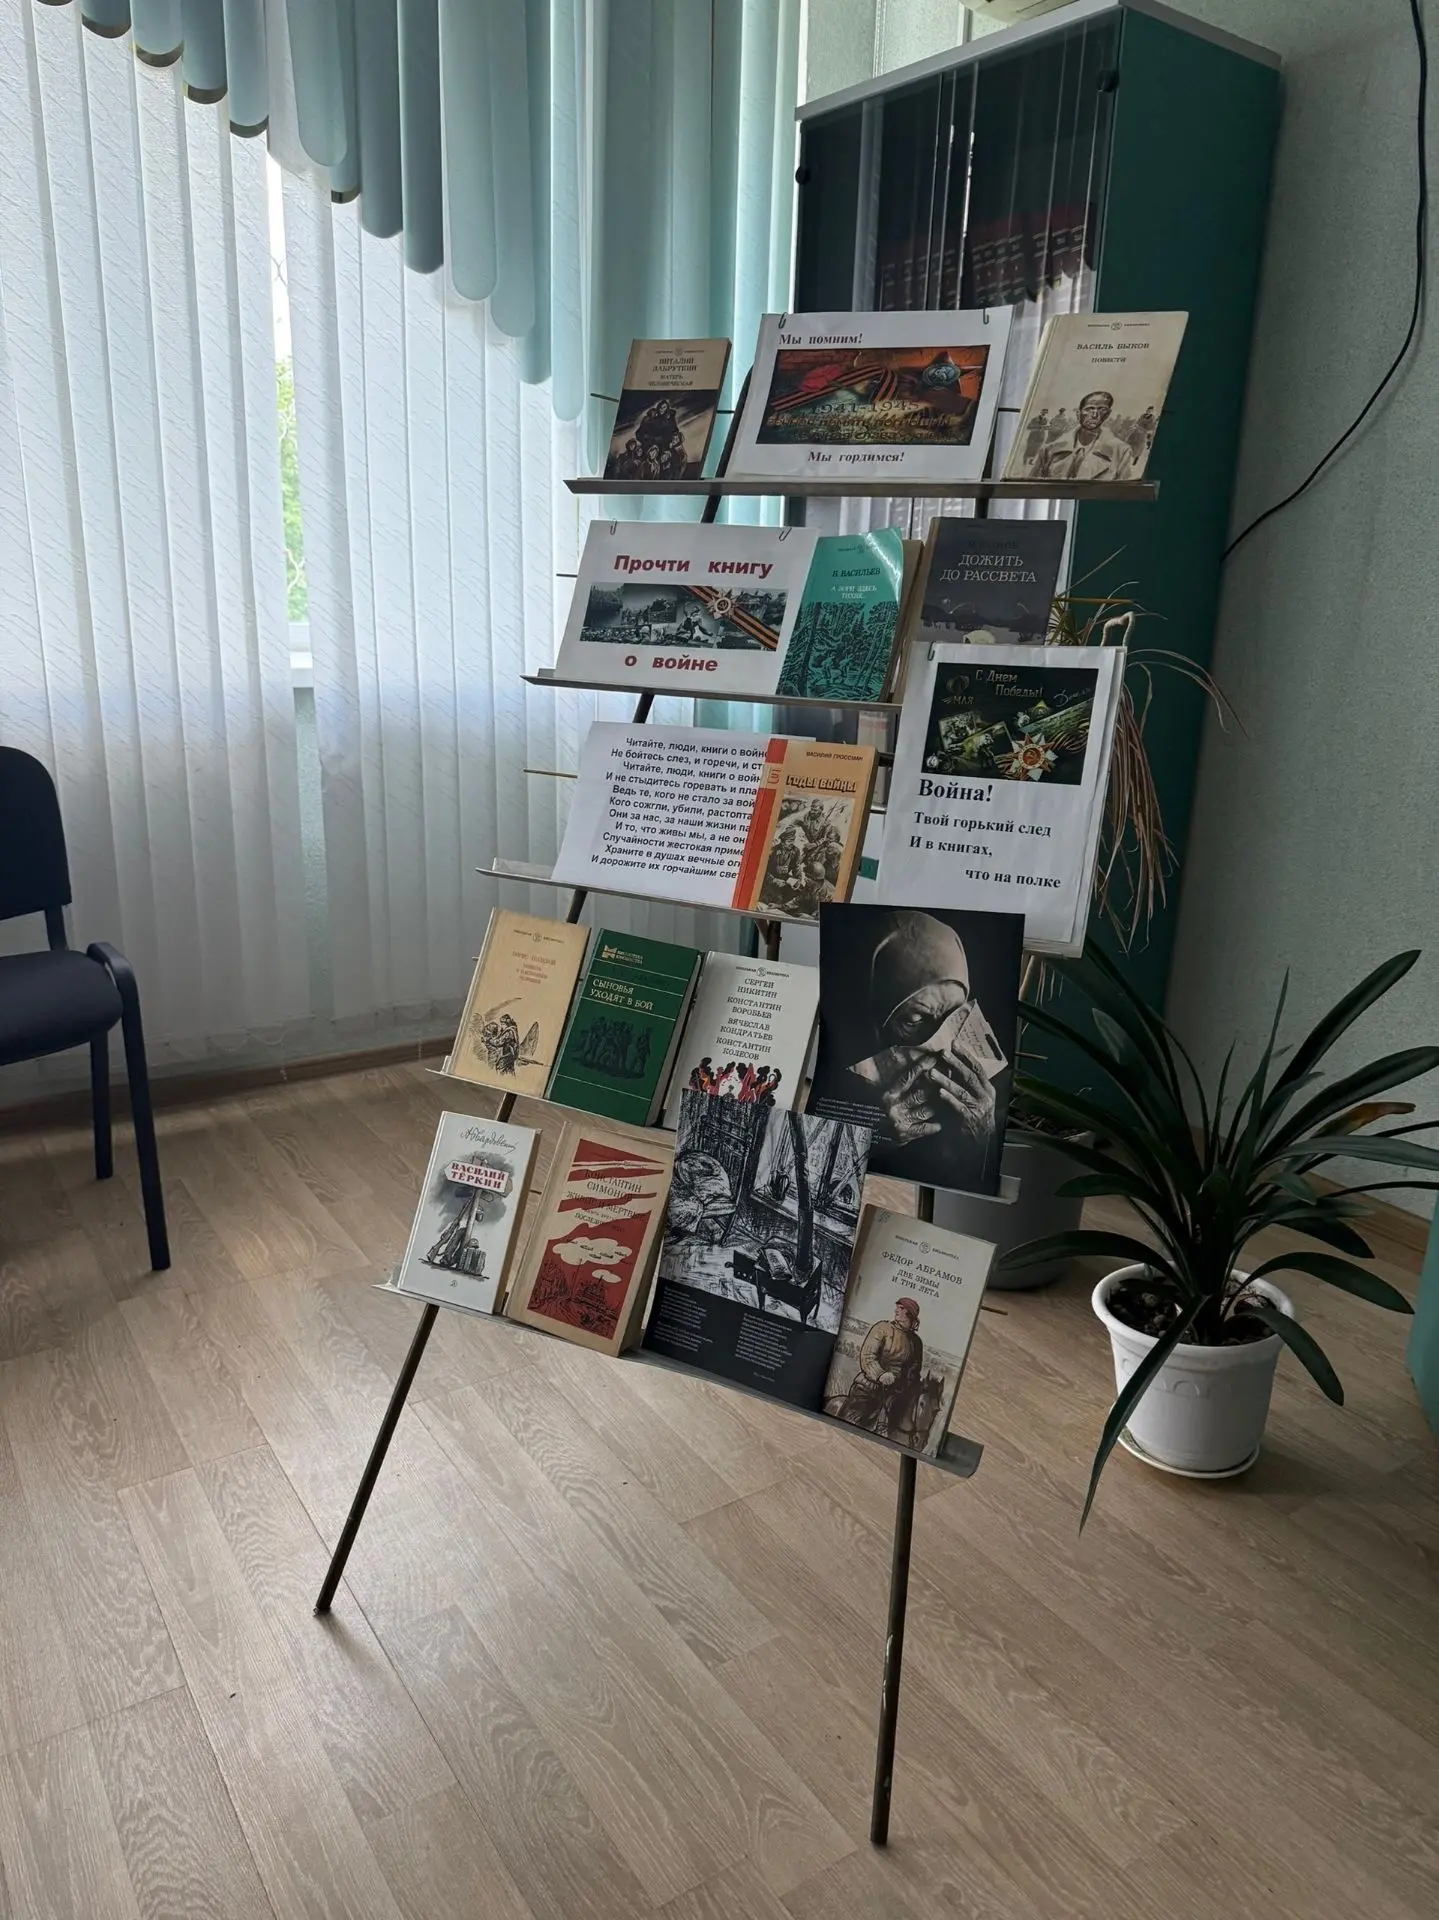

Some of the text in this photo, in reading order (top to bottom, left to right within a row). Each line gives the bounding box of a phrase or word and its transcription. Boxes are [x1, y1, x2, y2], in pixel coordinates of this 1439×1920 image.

[778, 333, 863, 345] Мы помним!
[1117, 342, 1150, 350] БЫКОВ
[811, 400, 920, 414] 1941-1945
[808, 452, 905, 464] Мы гордимся!
[613, 555, 774, 579] Прочти книгу
[957, 554, 1024, 567] ДОЖИТЬ
[840, 567, 881, 577] ВАСИЛЬЕВ
[939, 569, 1037, 583] ДО РАССВЕТА
[624, 653, 718, 672] о войне
[975, 669, 1019, 685] С Днем
[994, 683, 1044, 698] Победы!
[626, 737, 666, 750] Читайте,
[668, 742, 698, 753] люди,
[701, 745, 728, 755] книги
[610, 748, 623, 758] Не
[625, 749, 664, 761] бойтесь
[666, 755, 692, 765] слез,
[694, 757, 701, 765] и
[702, 758, 740, 770] горечи,
[742, 762, 749, 770] и
[623, 760, 664, 775] Читайте,
[666, 766, 696, 777] люди,
[698, 770, 726, 780] книги
[728, 773, 735, 781] о
[738, 773, 761, 783] войн
[605, 771, 613, 781] И
[628, 775, 681, 788] стыдитесь
[682, 781, 728, 793] горевать
[738, 786, 757, 796] пла
[818, 777, 857, 793] ВОЙНЫ
[917, 778, 994, 803] Война!
[612, 784, 756, 808] Ведь те, кого не стало за вой
[609, 796, 753, 820] Кого сожгли, убили, растопта
[609, 808, 750, 833] Они за нас, за наши жизни па
[913, 811, 1052, 838] Твой горький след
[602, 831, 665, 848] Случайности
[666, 840, 713, 853] жестокая
[615, 821, 623, 830] И
[625, 824, 638, 833] то,
[640, 826, 657, 834] что
[659, 828, 687, 838] живы
[688, 832, 707, 841] мы,
[709, 833, 716, 841] а
[733, 836, 746, 844] он
[604, 844, 644, 857] Храните
[653, 851, 685, 862] душах
[687, 855, 725, 866] вечные
[727, 860, 741, 868] ог
[909, 835, 993, 858] И в книгах,
[591, 854, 738, 879] И дорожите их горчайшим све
[965, 869, 1061, 889] что на полке
[592, 978, 635, 995] СЫНОВЬЯ
[737, 985, 778, 999] НИКИТИН
[589, 988, 654, 1011] УХОДЯТ В БОЙ
[727, 996, 782, 1012] КОНСТАНТИН
[732, 1006, 772, 1019] ВОРОБЬЕВ
[719, 1025, 773, 1041] КОНДРАТЬЕВ
[727, 1017, 771, 1032] ВЯЧЕСЛАВ
[715, 1036, 772, 1053] КОНСТАНТИН
[722, 1047, 760, 1061] КОЛЕСОВ
[450, 1162, 506, 1181] ВАСИЛИЙ
[584, 1169, 642, 1194] КОНСТАНТИН
[586, 1181, 633, 1201] СИМОНОВ
[881, 1251, 963, 1285] ФЕДОР АБРАМОВ
[891, 1275, 940, 1298] И ТРИ ЛЕТА
[897, 1269, 940, 1289] ДВЕ ЗИМЫ
